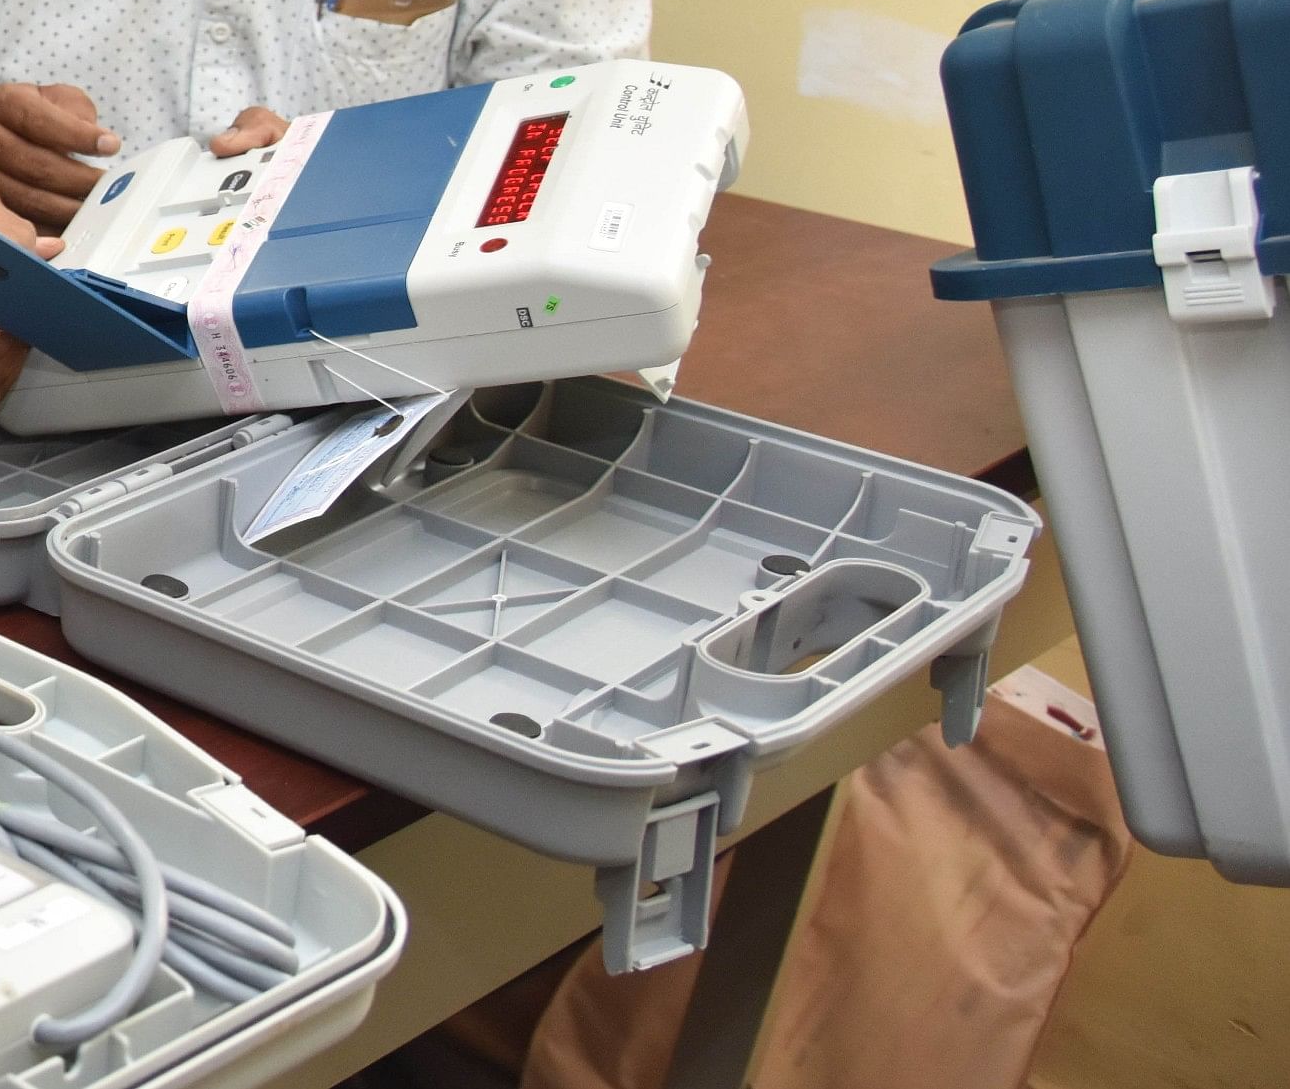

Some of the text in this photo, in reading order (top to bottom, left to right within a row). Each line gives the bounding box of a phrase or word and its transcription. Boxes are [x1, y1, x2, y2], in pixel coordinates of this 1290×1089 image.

[609, 85, 638, 129] Control Unit
[487, 148, 536, 224] PROGRESS
[448, 241, 465, 258] Busy
[517, 308, 532, 328] DSC
[211, 332, 222, 340] H
